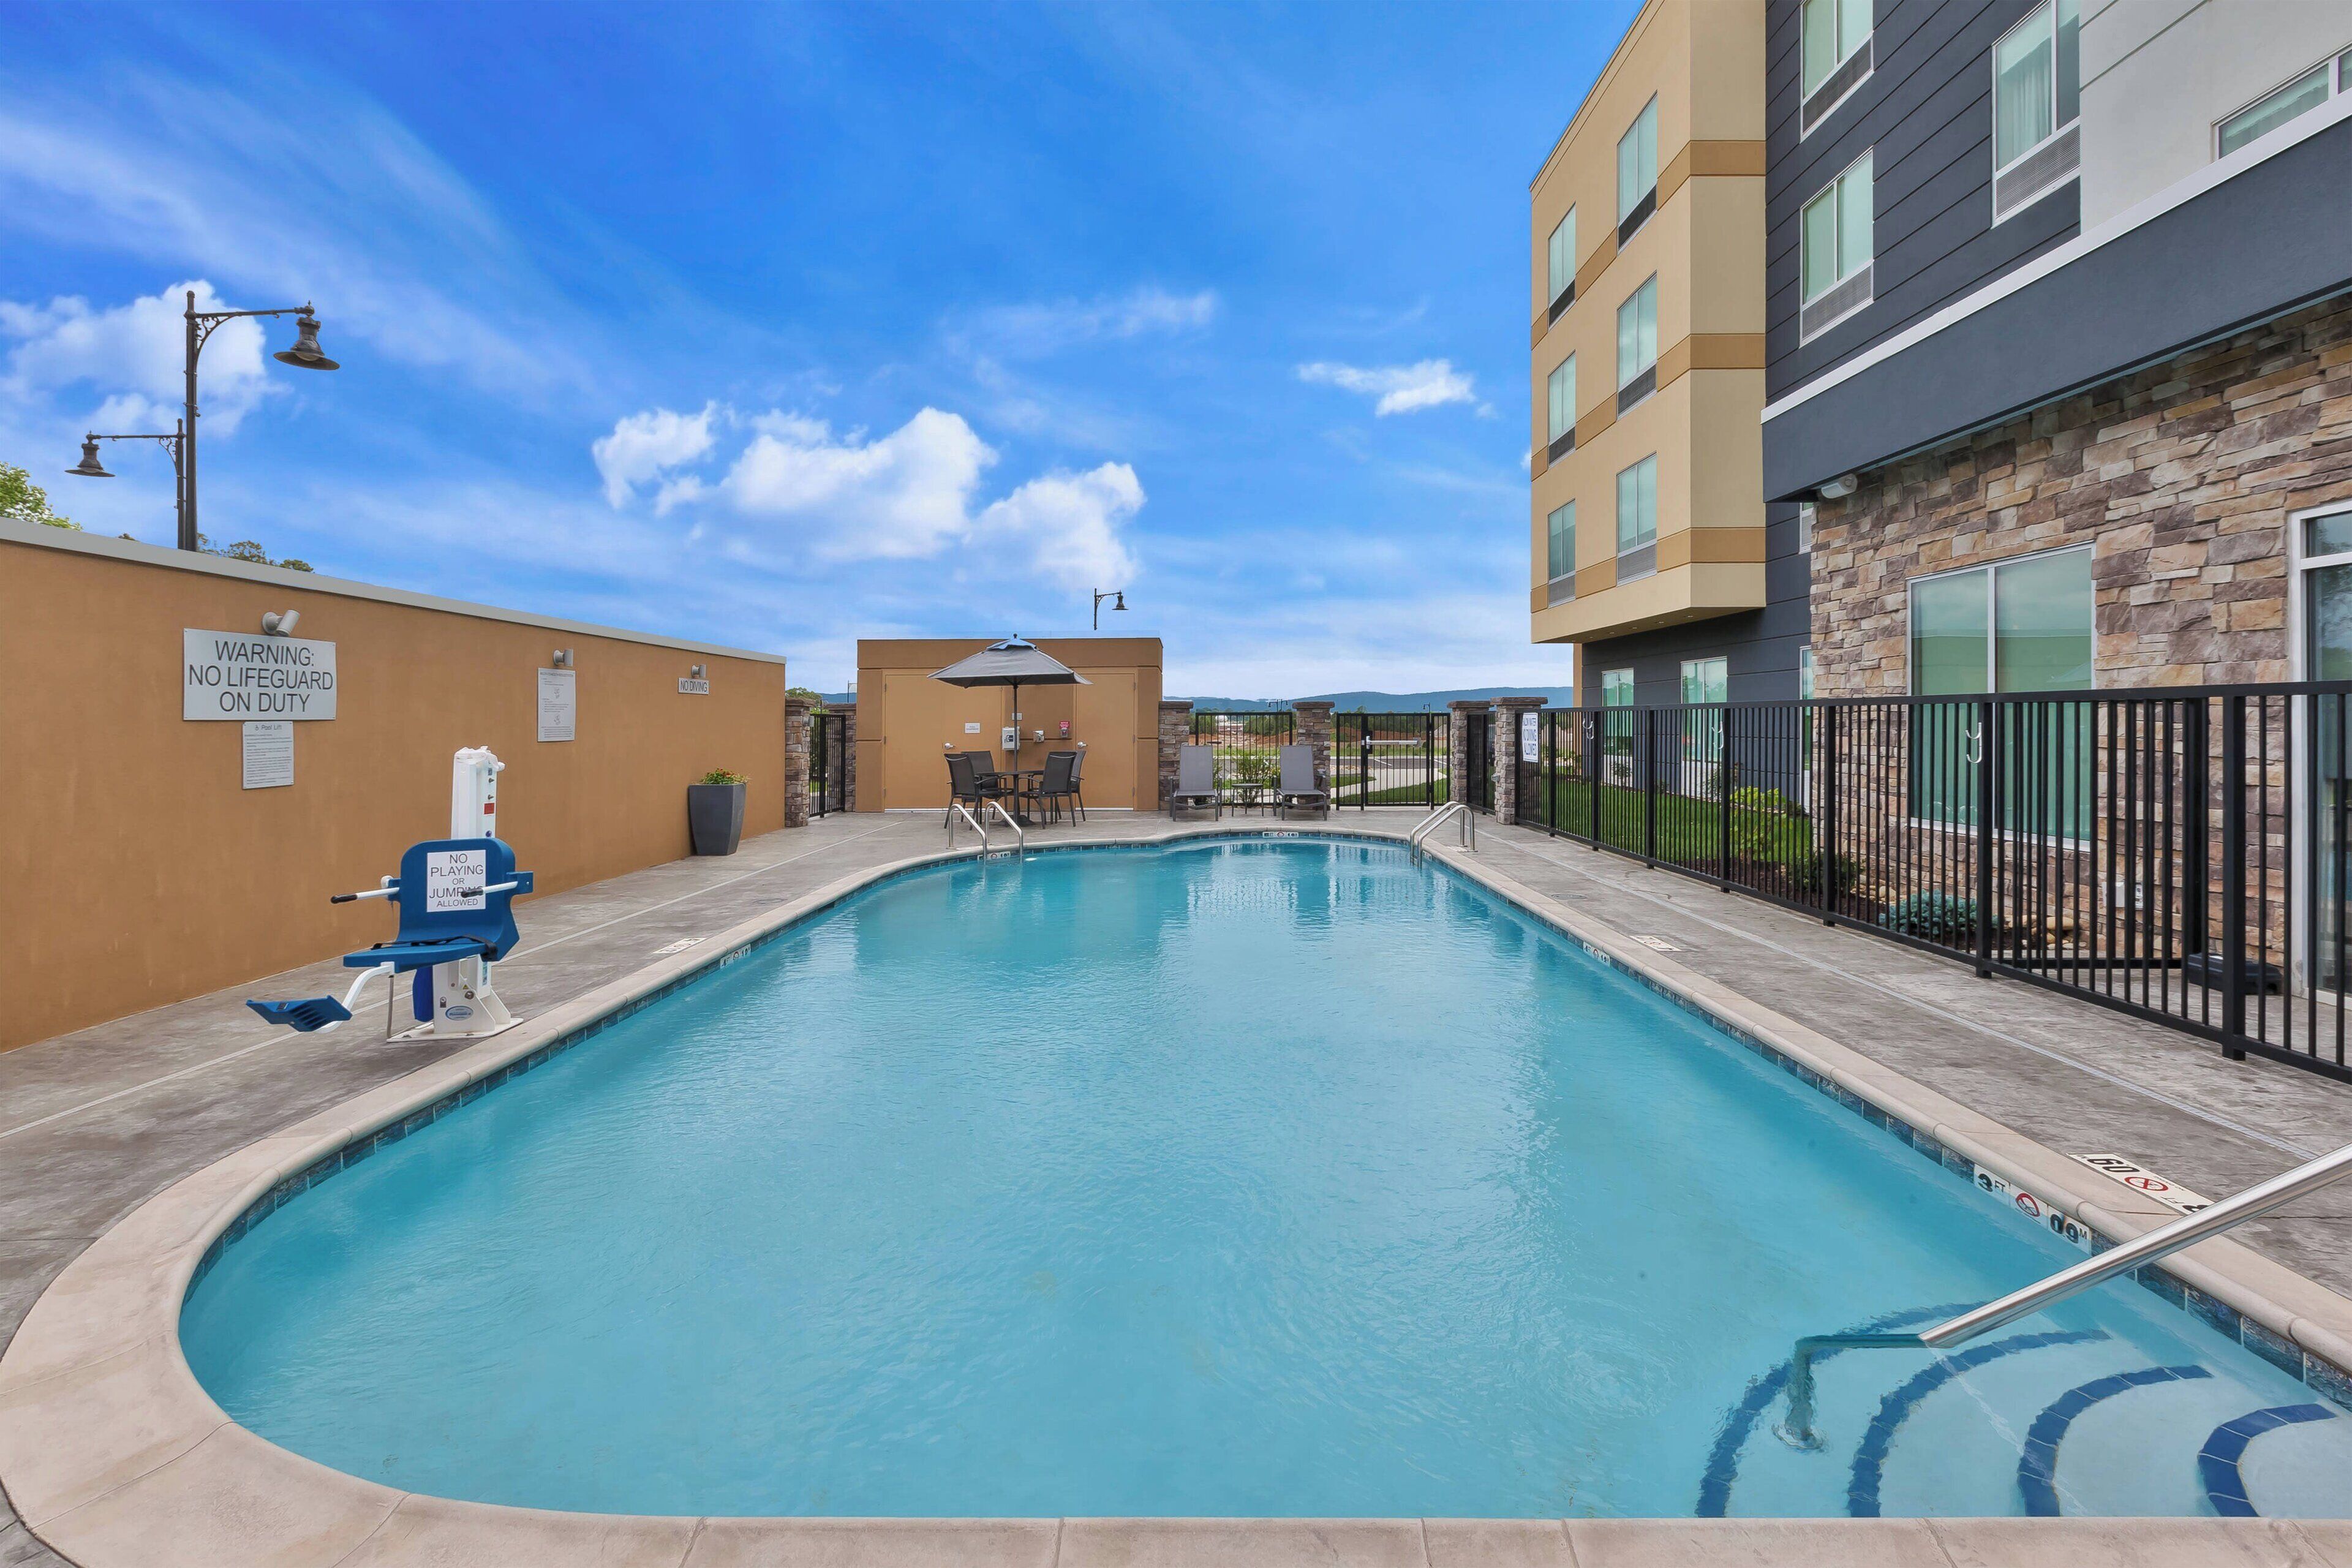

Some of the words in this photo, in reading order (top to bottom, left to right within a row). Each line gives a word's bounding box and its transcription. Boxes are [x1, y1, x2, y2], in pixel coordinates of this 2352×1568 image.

[215, 640, 314, 666] WARNING:
[189, 664, 221, 686] NO
[227, 666, 334, 690] LIFEGUARD
[680, 680, 688, 691] NO
[690, 680, 707, 692] DIVING
[220, 692, 251, 712] ON
[258, 693, 310, 712] DUTY
[450, 853, 468, 864] NO
[431, 864, 483, 877] PLAYING
[429, 886, 483, 899] JUMP
[437, 899, 478, 907] ALLOWED
[1978, 1173, 1993, 1192] 3
[1994, 1180, 2005, 1192] FT
[2079, 1227, 2087, 1240] M
